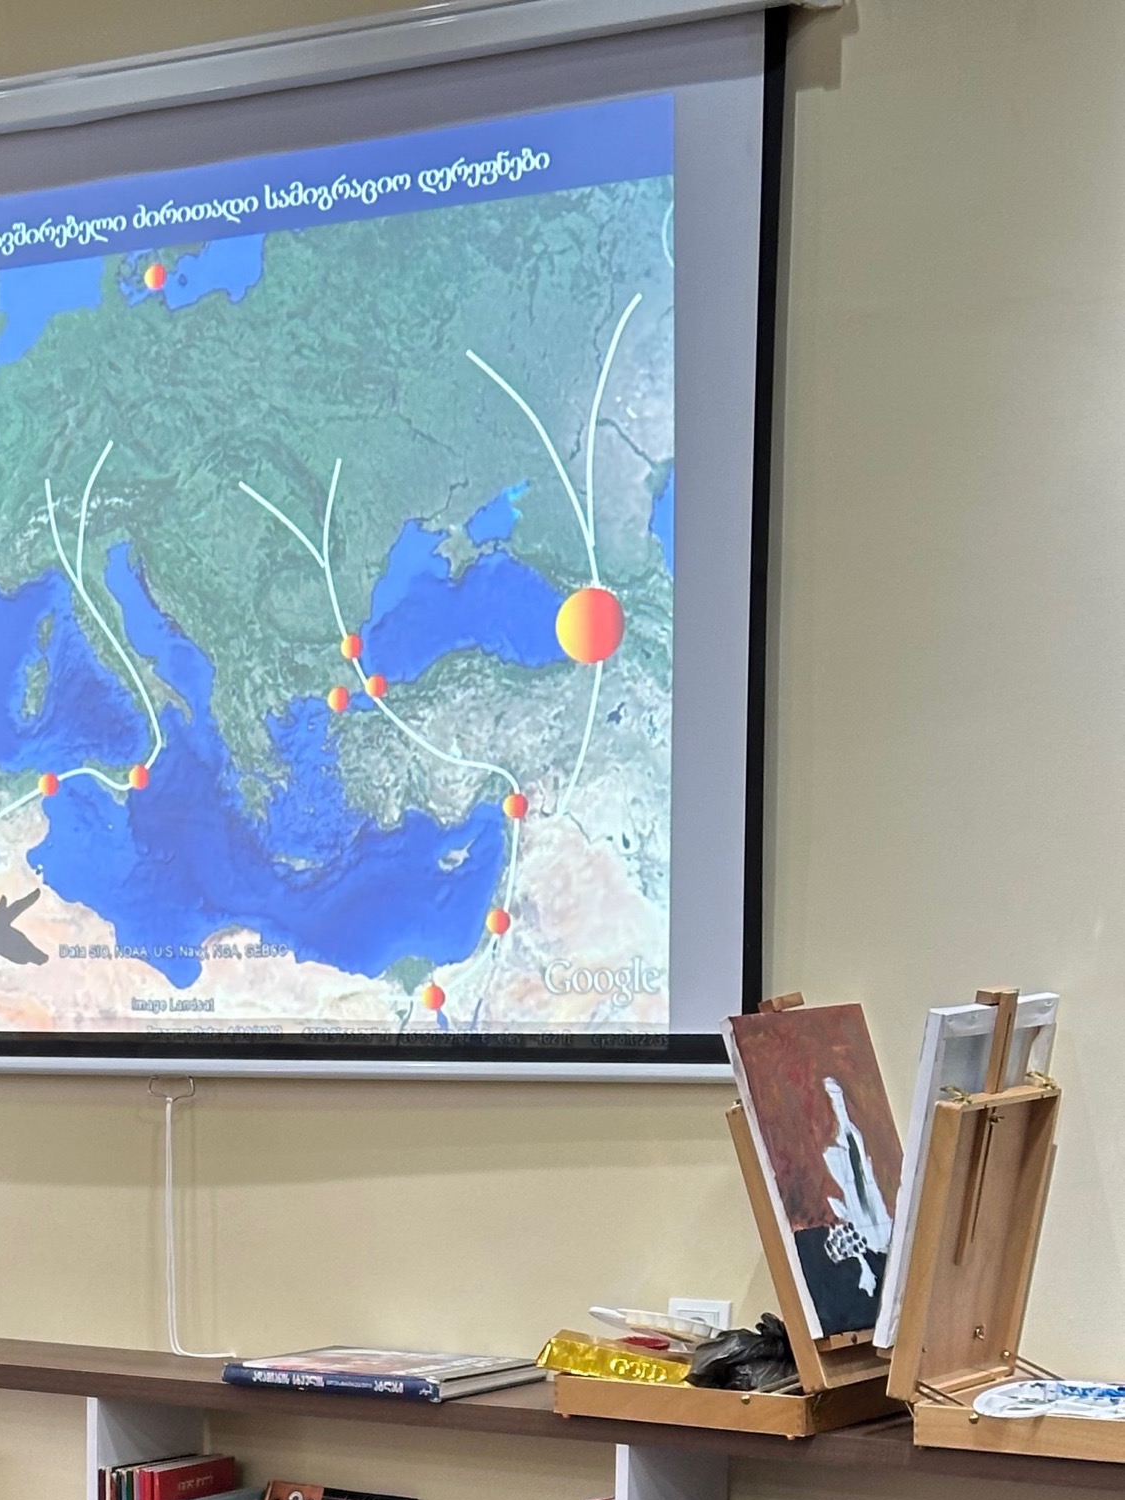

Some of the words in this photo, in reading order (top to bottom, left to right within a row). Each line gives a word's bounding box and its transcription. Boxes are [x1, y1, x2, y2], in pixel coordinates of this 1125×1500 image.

[132, 195, 260, 230] ძირითადი
[263, 172, 412, 212] სამიგრაციო
[417, 147, 551, 195] დერეფნები
[58, 943, 87, 959] Data
[543, 955, 662, 1007] Google
[169, 996, 215, 1013] Landsat
